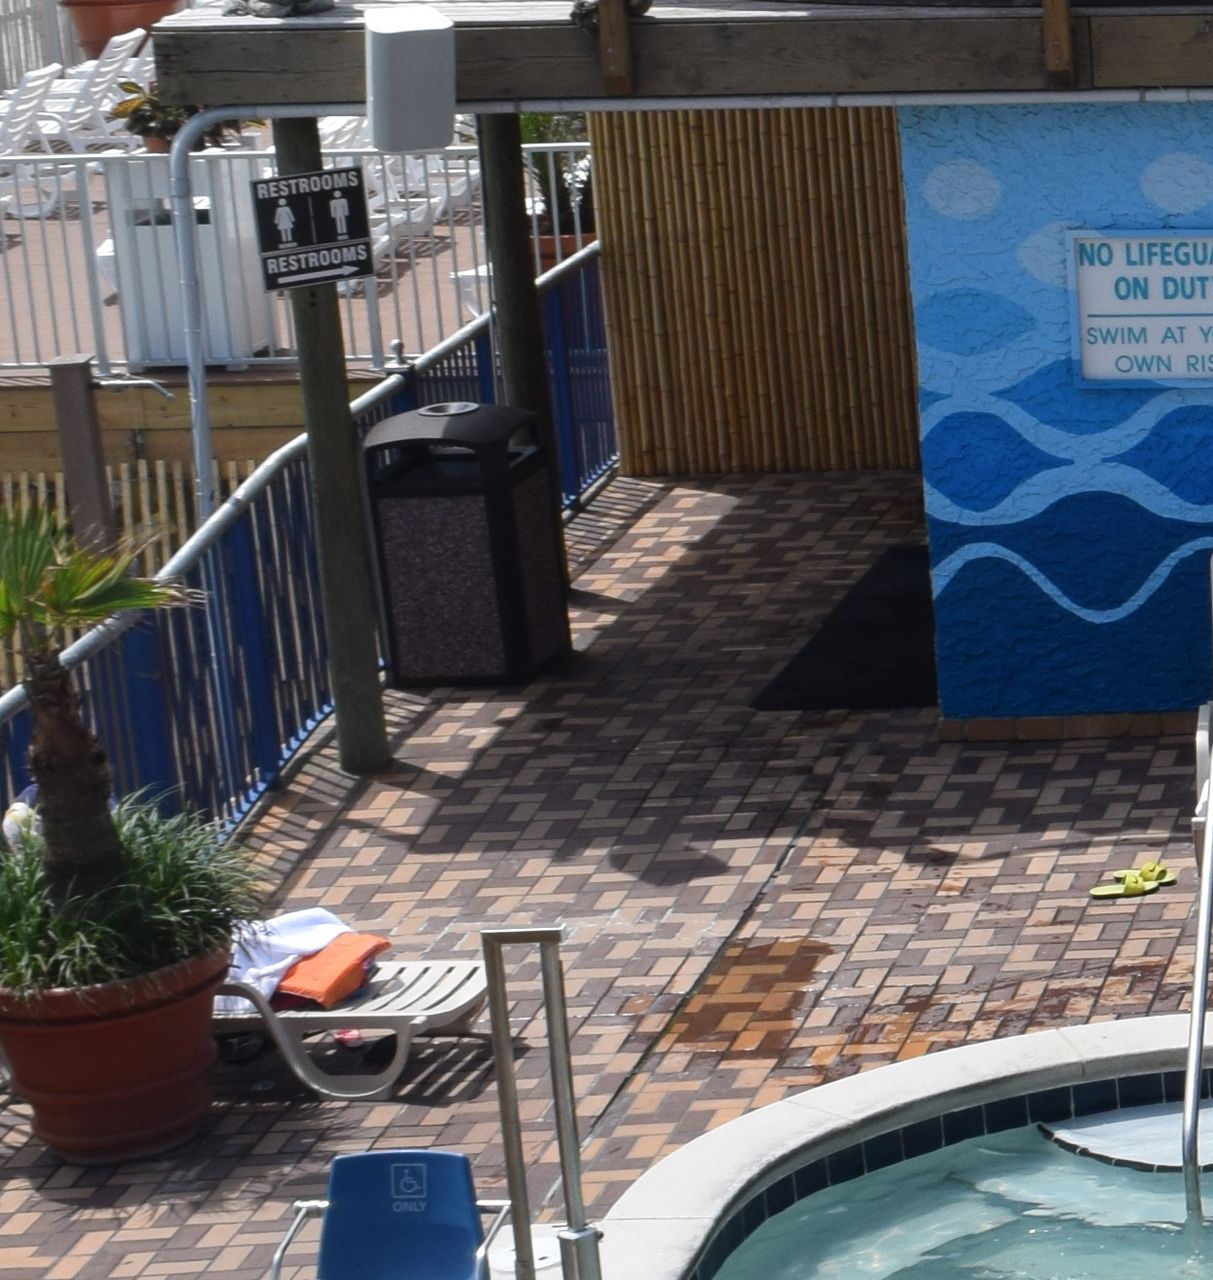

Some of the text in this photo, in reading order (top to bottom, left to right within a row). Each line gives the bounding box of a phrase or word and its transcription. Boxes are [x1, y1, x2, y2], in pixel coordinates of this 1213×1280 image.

[256, 171, 359, 199] RESTROOMS
[266, 245, 368, 275] RESTROOMS
[1078, 242, 1113, 266] NO
[1114, 276, 1149, 300] ON
[1087, 326, 1148, 345] SWIM
[1161, 325, 1187, 344] AT
[1115, 355, 1172, 374] OWN
[392, 1200, 428, 1213] ONLY
